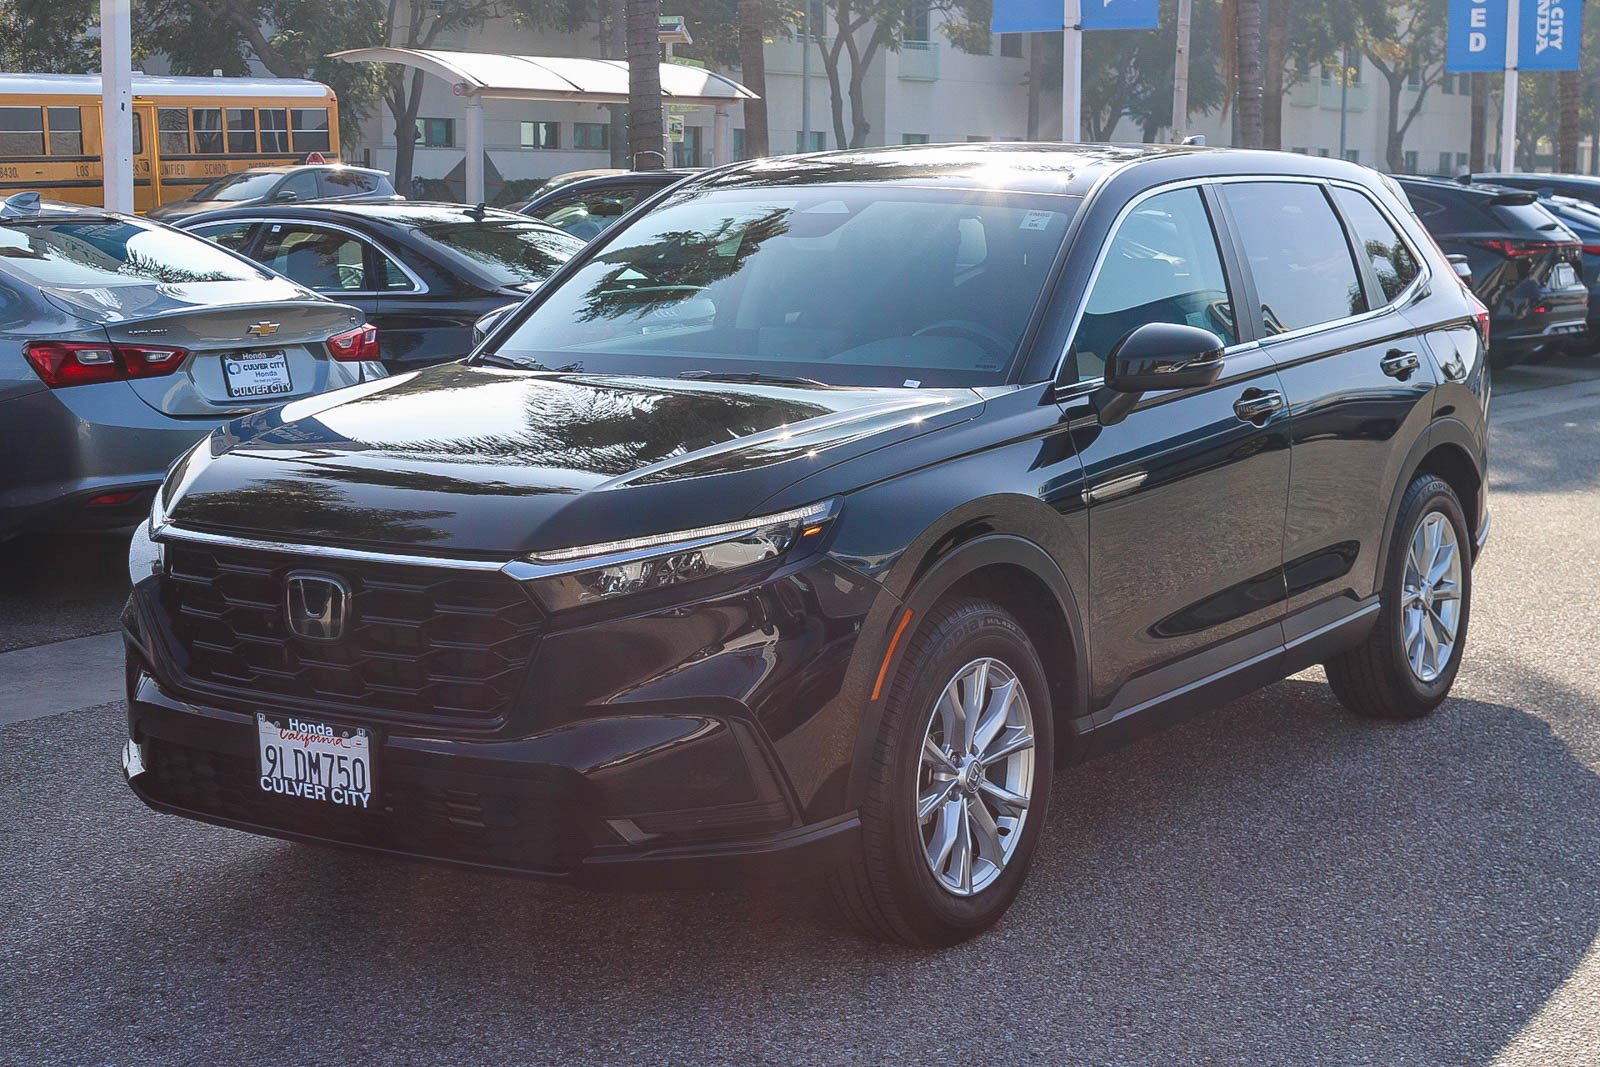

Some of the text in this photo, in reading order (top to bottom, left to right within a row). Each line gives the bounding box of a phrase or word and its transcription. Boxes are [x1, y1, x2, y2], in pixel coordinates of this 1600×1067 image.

[1469, 0, 1487, 52] ED
[1550, 7, 1564, 50] CITY
[76, 166, 89, 176] LOS
[160, 164, 185, 176] UNIFIED
[242, 352, 267, 360] Honda
[243, 363, 269, 371] CULVER
[233, 383, 291, 396] CULVER CITY
[288, 718, 334, 736] Honda
[265, 745, 366, 791] 9LDM750
[260, 776, 370, 809] CULVER CITY
